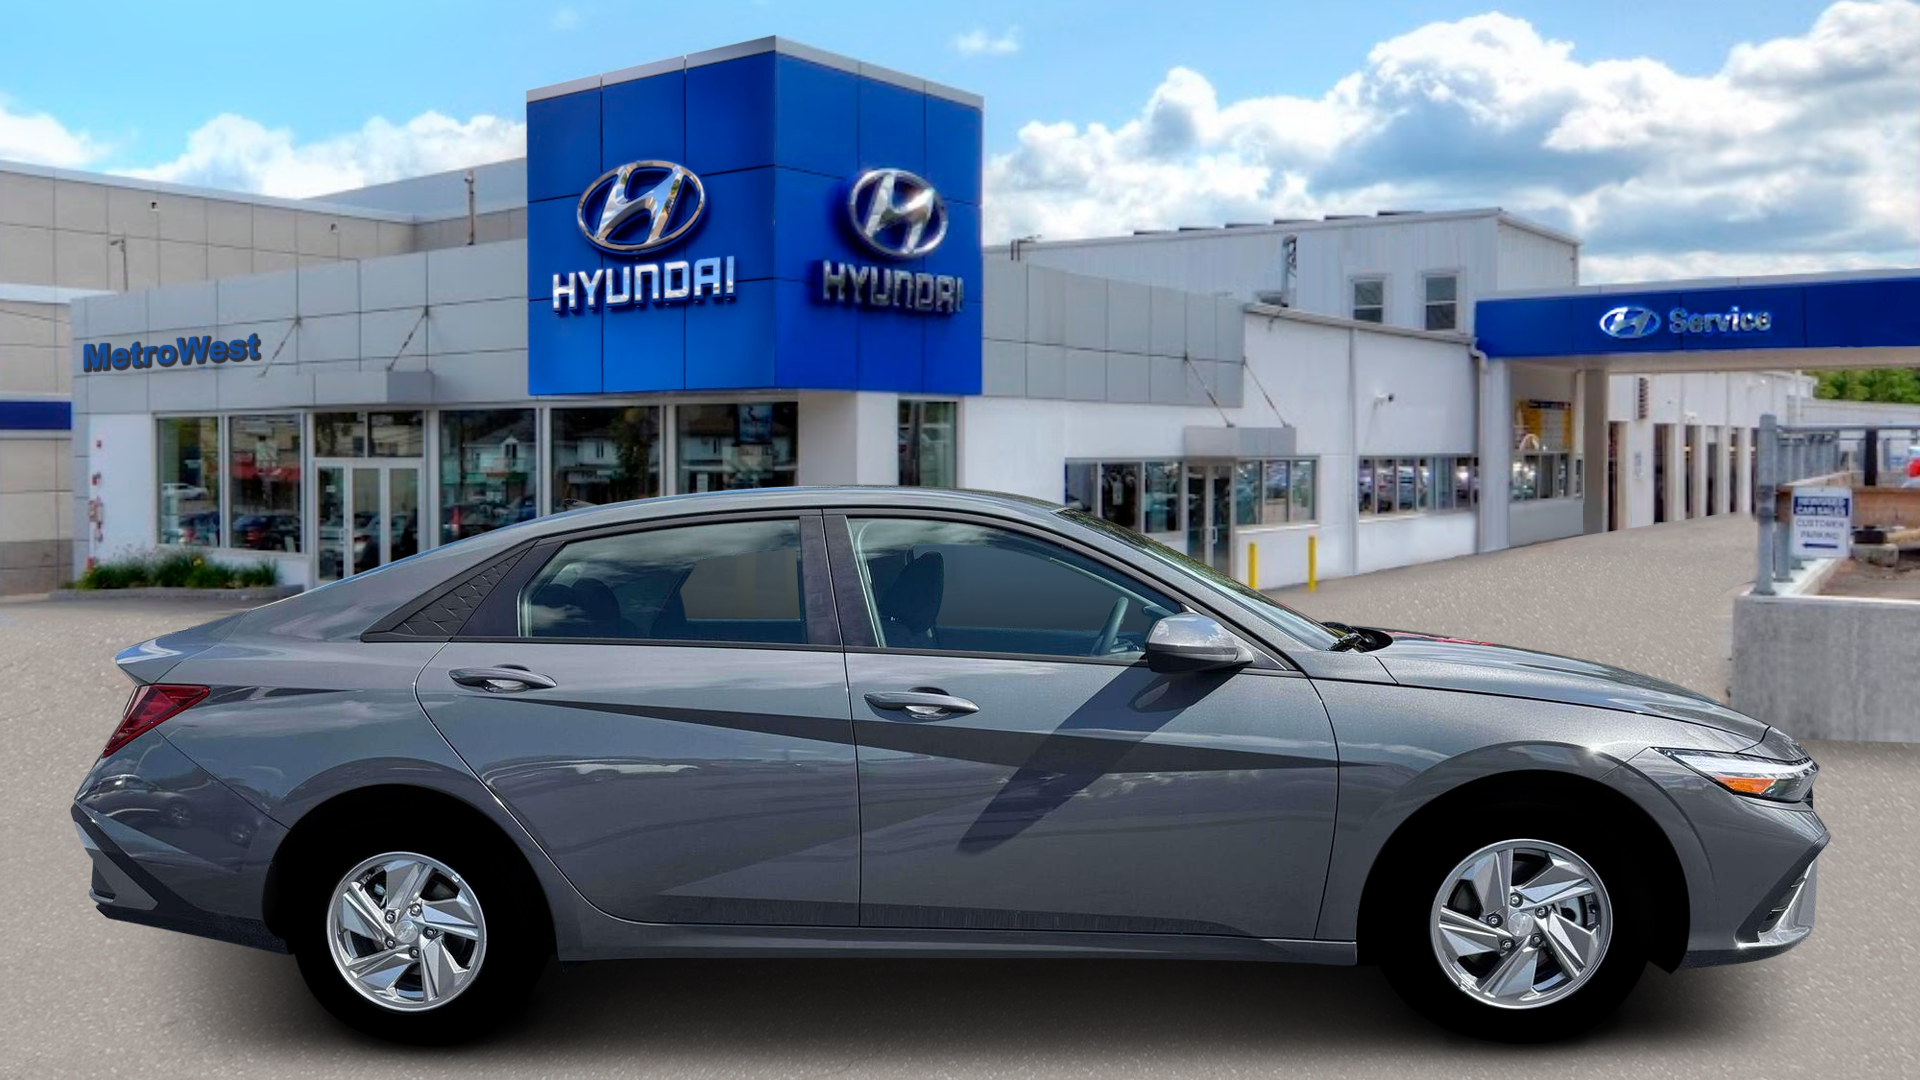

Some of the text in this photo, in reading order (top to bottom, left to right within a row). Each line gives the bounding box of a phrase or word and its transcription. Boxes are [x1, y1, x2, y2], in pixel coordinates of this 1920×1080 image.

[553, 255, 736, 312] HYUNDAI
[822, 259, 965, 314] HYUNDAI
[1668, 304, 1773, 335] Service
[83, 332, 262, 373] MetroWest
[1796, 519, 1845, 528] CUSTOMER
[1800, 530, 1841, 540] PARKING
